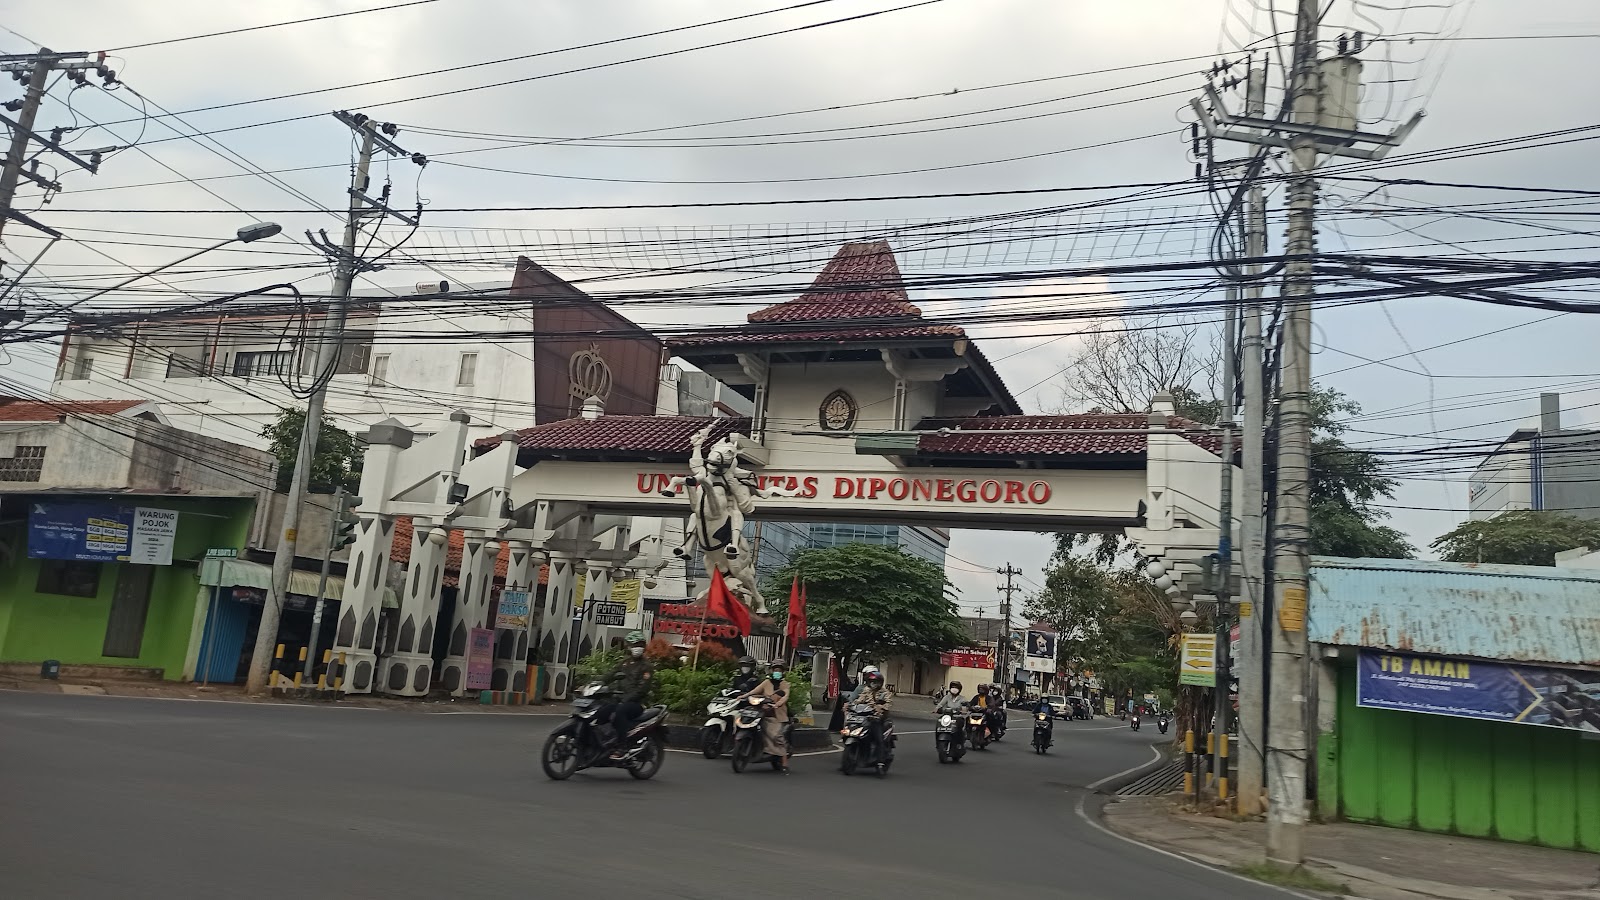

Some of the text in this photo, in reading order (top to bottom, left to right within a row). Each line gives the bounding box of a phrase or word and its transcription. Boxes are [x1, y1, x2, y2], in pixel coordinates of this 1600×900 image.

[833, 477, 1052, 504] DIPONEGORO
[139, 510, 175, 520] WARUNG
[142, 519, 170, 528] POJOK
[504, 592, 528, 603] TAHU
[499, 603, 528, 615] BAKSO
[597, 604, 626, 614] POTONG
[596, 615, 624, 625] RAMBUT
[654, 619, 739, 639] DIPONEGORO
[1379, 655, 1470, 680] TB AMAN
